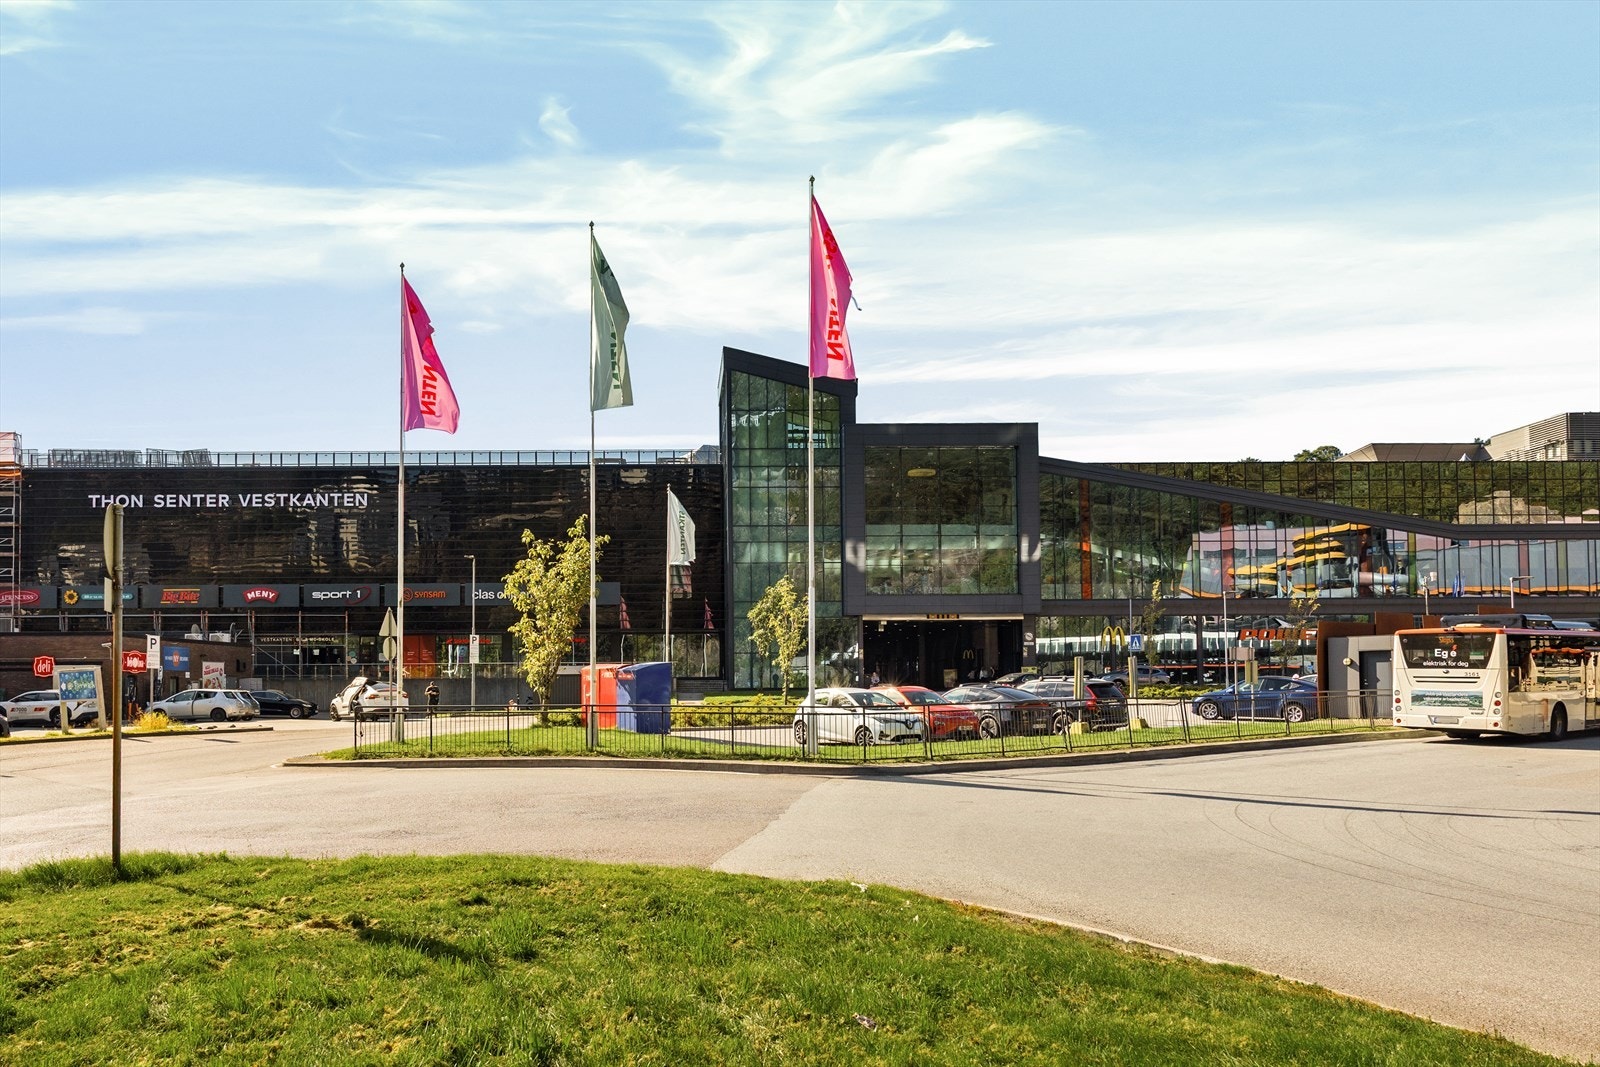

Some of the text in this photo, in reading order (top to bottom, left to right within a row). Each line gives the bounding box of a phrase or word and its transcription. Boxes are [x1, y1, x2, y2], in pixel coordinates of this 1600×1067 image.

[88, 493, 368, 508] THON SENTER VESTKANTEN
[246, 590, 276, 600] MENY
[312, 590, 361, 601] sport 1
[414, 590, 446, 599] SYNSAM
[472, 589, 495, 600] clas
[150, 637, 157, 650] P
[471, 636, 478, 645] P
[1434, 648, 1449, 659] Eg
[37, 659, 51, 673] deli
[1457, 660, 1469, 668] deg
